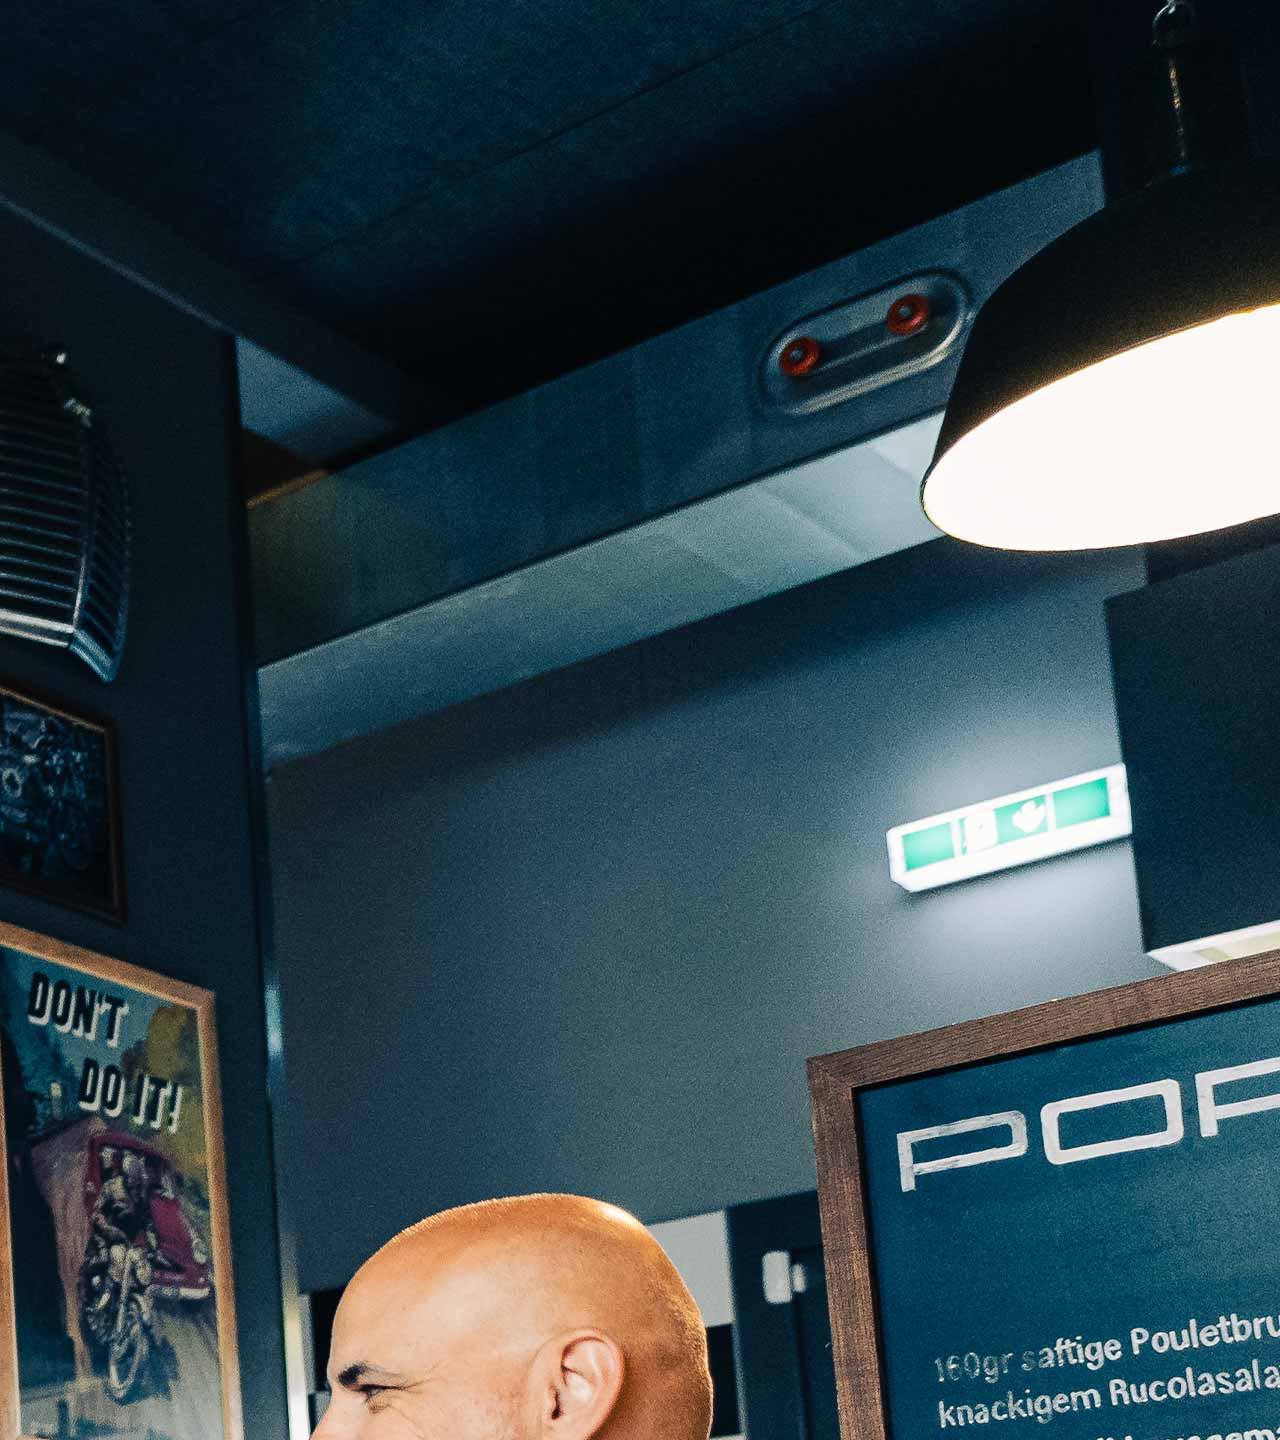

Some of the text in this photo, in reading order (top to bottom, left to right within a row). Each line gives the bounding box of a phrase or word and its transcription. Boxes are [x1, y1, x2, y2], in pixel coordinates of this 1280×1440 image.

[28, 972, 130, 1048] DON'T
[79, 1057, 183, 1134] DO IT!
[1021, 1335, 1122, 1371] saftige
[939, 1388, 1101, 1428] knackigem
